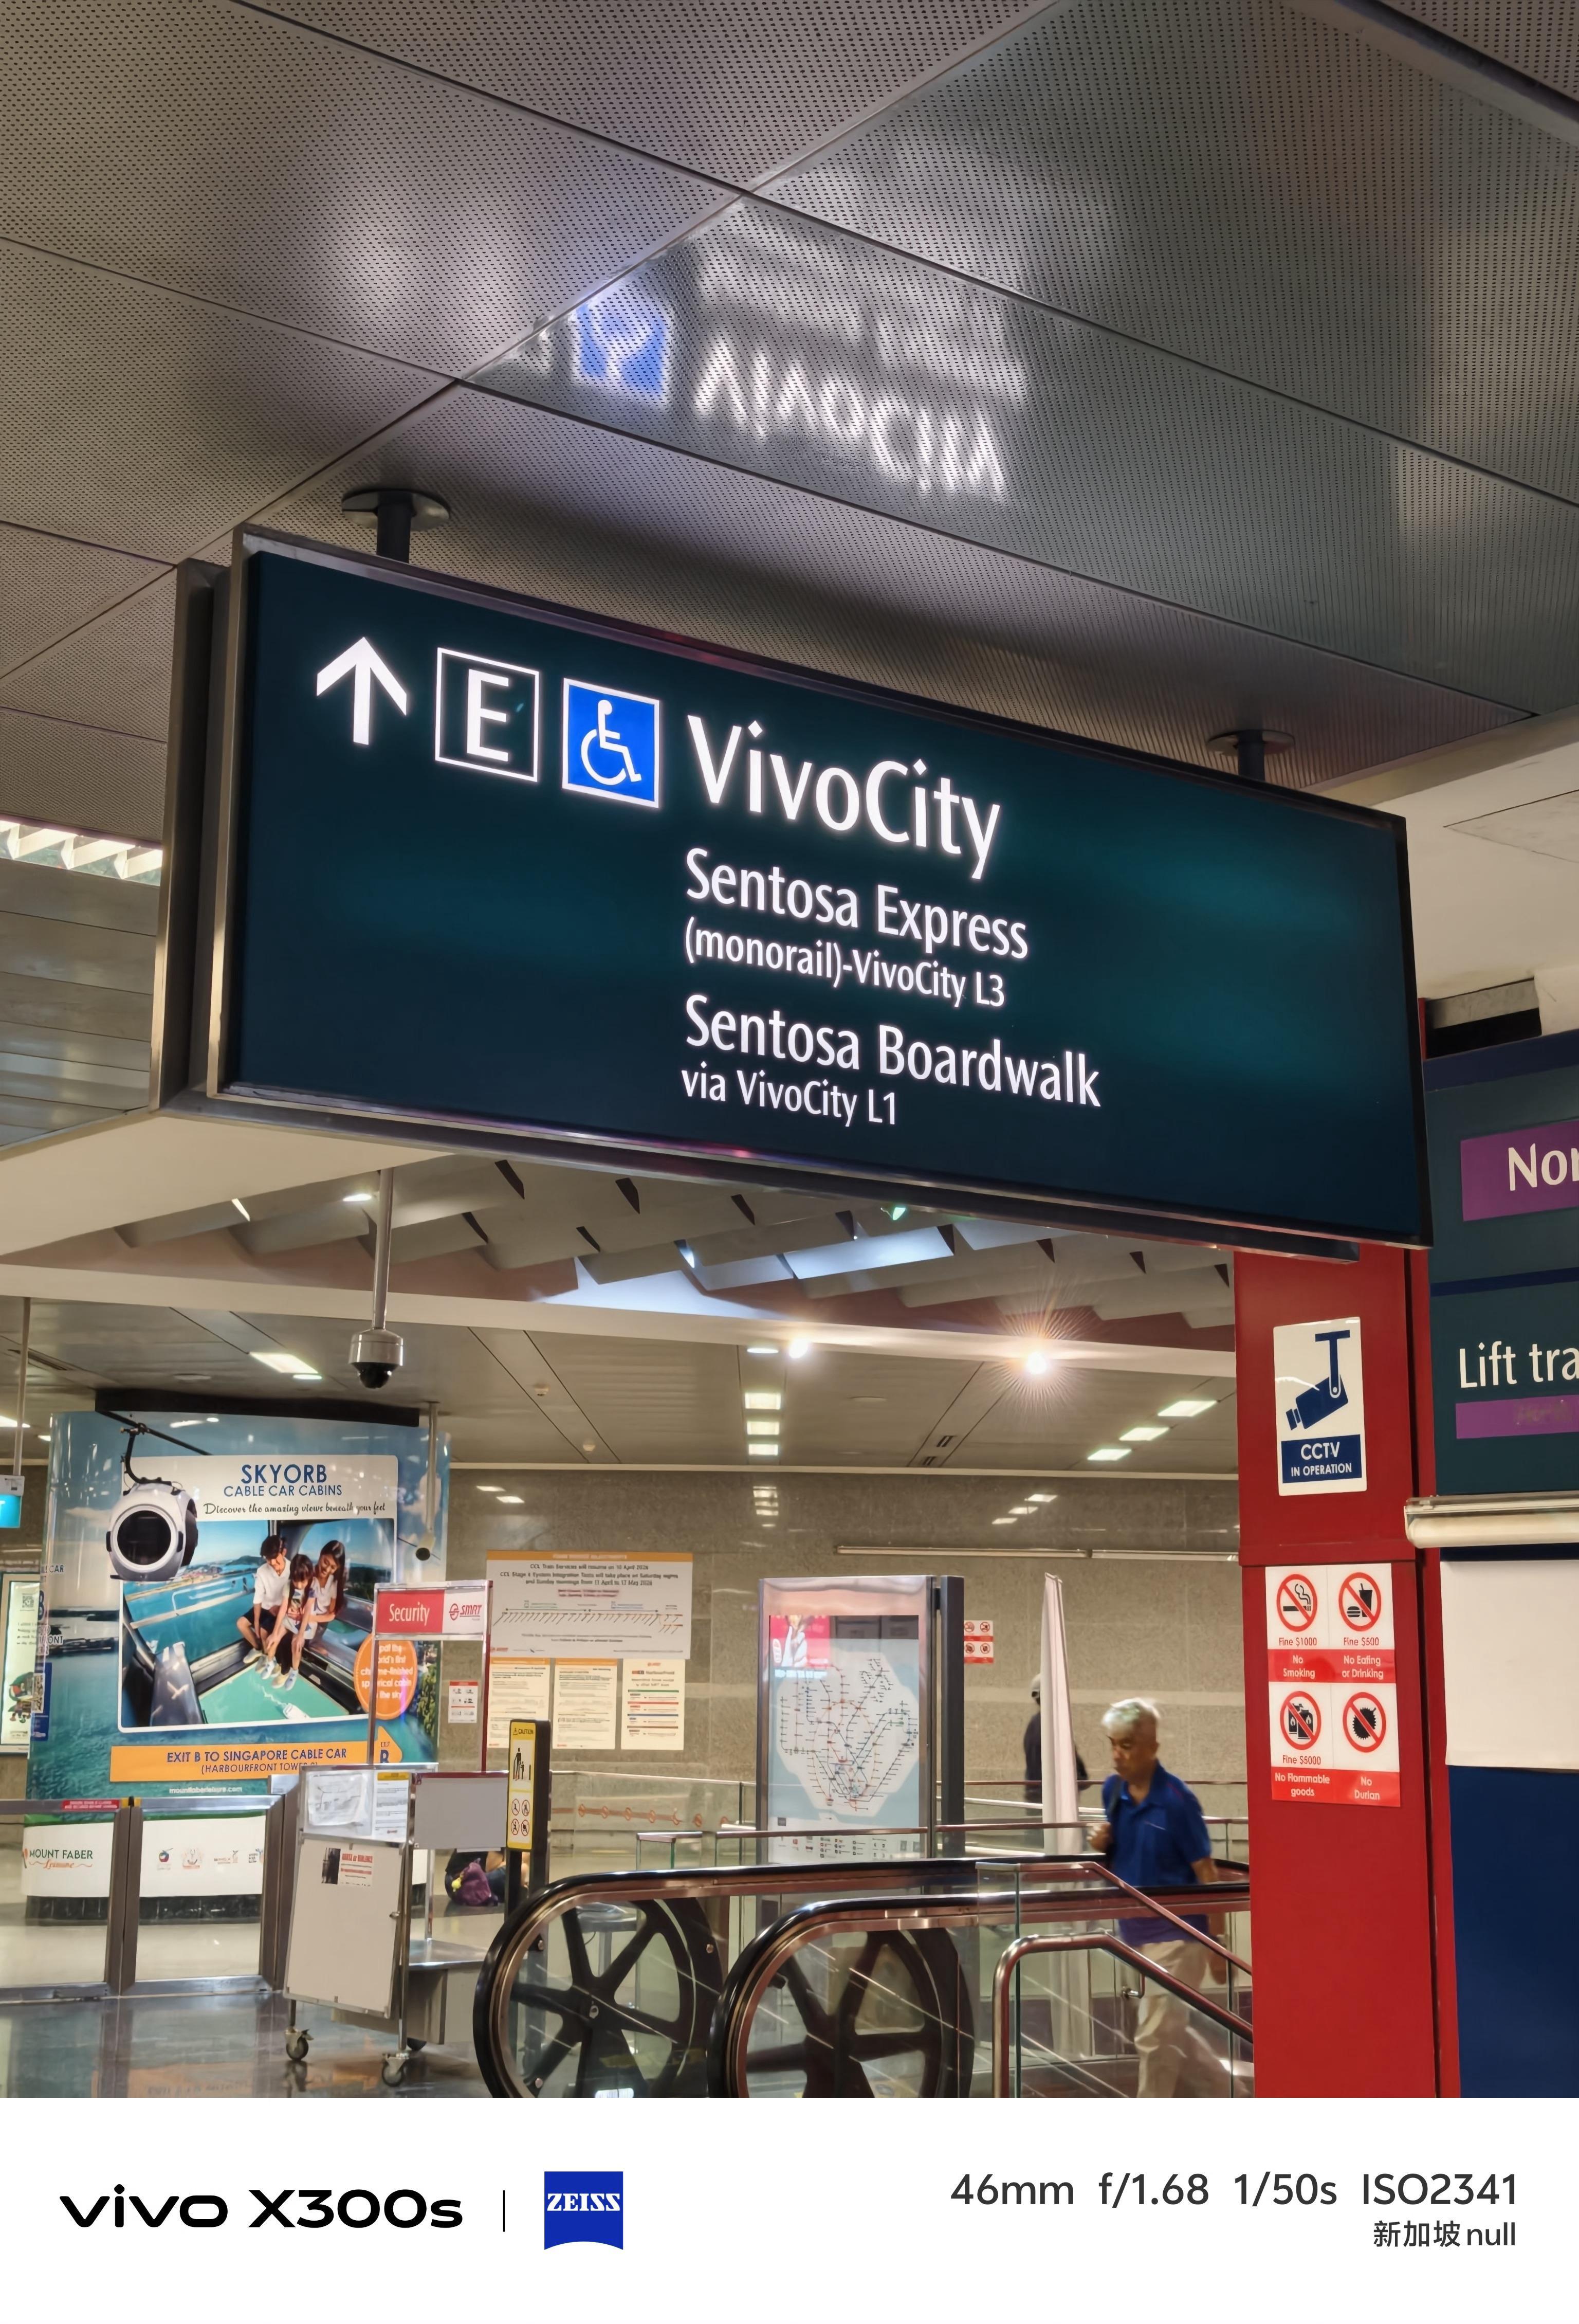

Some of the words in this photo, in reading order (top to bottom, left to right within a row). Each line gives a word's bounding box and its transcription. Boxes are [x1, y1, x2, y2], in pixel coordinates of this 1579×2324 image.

[467, 669, 509, 762] E
[687, 715, 1000, 880] VivoCity
[686, 847, 858, 928] Sentosa
[878, 884, 1028, 959] Express
[685, 917, 966, 1008] (monorail)-VivoCity
[976, 971, 1005, 1008] L3
[686, 994, 859, 1070] Sentosa
[879, 1024, 1101, 1107] Boardwalk
[682, 1061, 726, 1102] via
[737, 1069, 857, 1127] VivoCity
[868, 1089, 896, 1125] L1
[1460, 1341, 1517, 1388] Lift
[1529, 1343, 1579, 1382] tra
[1301, 1442, 1340, 1460] CCTV
[241, 1464, 327, 1484] SKYORB
[1291, 1466, 1300, 1477] IN
[1303, 1463, 1352, 1476] OPERATION
[224, 1485, 264, 1497] CABLE
[268, 1485, 295, 1496] CAR
[299, 1484, 342, 1496] CABINS
[203, 1503, 246, 1514] Discover
[249, 1503, 263, 1513] the
[265, 1504, 299, 1516] amazing
[325, 1502, 354, 1512] beneath
[355, 1505, 371, 1515] your
[373, 1501, 385, 1515] feet
[389, 1602, 430, 1626] Security
[460, 1605, 482, 1615] SMRT
[1279, 1637, 1293, 1646] Fine
[1296, 1637, 1317, 1647] $1000
[1344, 1637, 1358, 1646] Fine
[1362, 1637, 1379, 1647] $500
[1293, 1655, 1303, 1664] No
[1344, 1655, 1355, 1664] No
[1357, 1655, 1381, 1666] Eating
[1283, 1668, 1315, 1679] Smoking
[1342, 1669, 1351, 1678] or
[1352, 1668, 1384, 1680] Drinking
[167, 1752, 191, 1763] EXIT
[194, 1752, 201, 1762] B
[205, 1751, 220, 1762] TO
[223, 1750, 287, 1762] SINGAPORE
[291, 1749, 323, 1759] CABLE
[326, 1748, 346, 1758] CAR
[1282, 1755, 1297, 1764] Fine
[1299, 1755, 1321, 1765] $5000
[201, 1763, 277, 1775] (HARBOURFRONT
[280, 1762, 307, 1770] TOW
[1275, 1772, 1286, 1782] No
[1288, 1773, 1330, 1784] Flammable
[1361, 1777, 1372, 1786] No
[1291, 1787, 1315, 1797] goods
[1354, 1789, 1380, 1801] Durian
[29, 1849, 59, 1859] MOUNT
[62, 1850, 93, 1859] FABER
